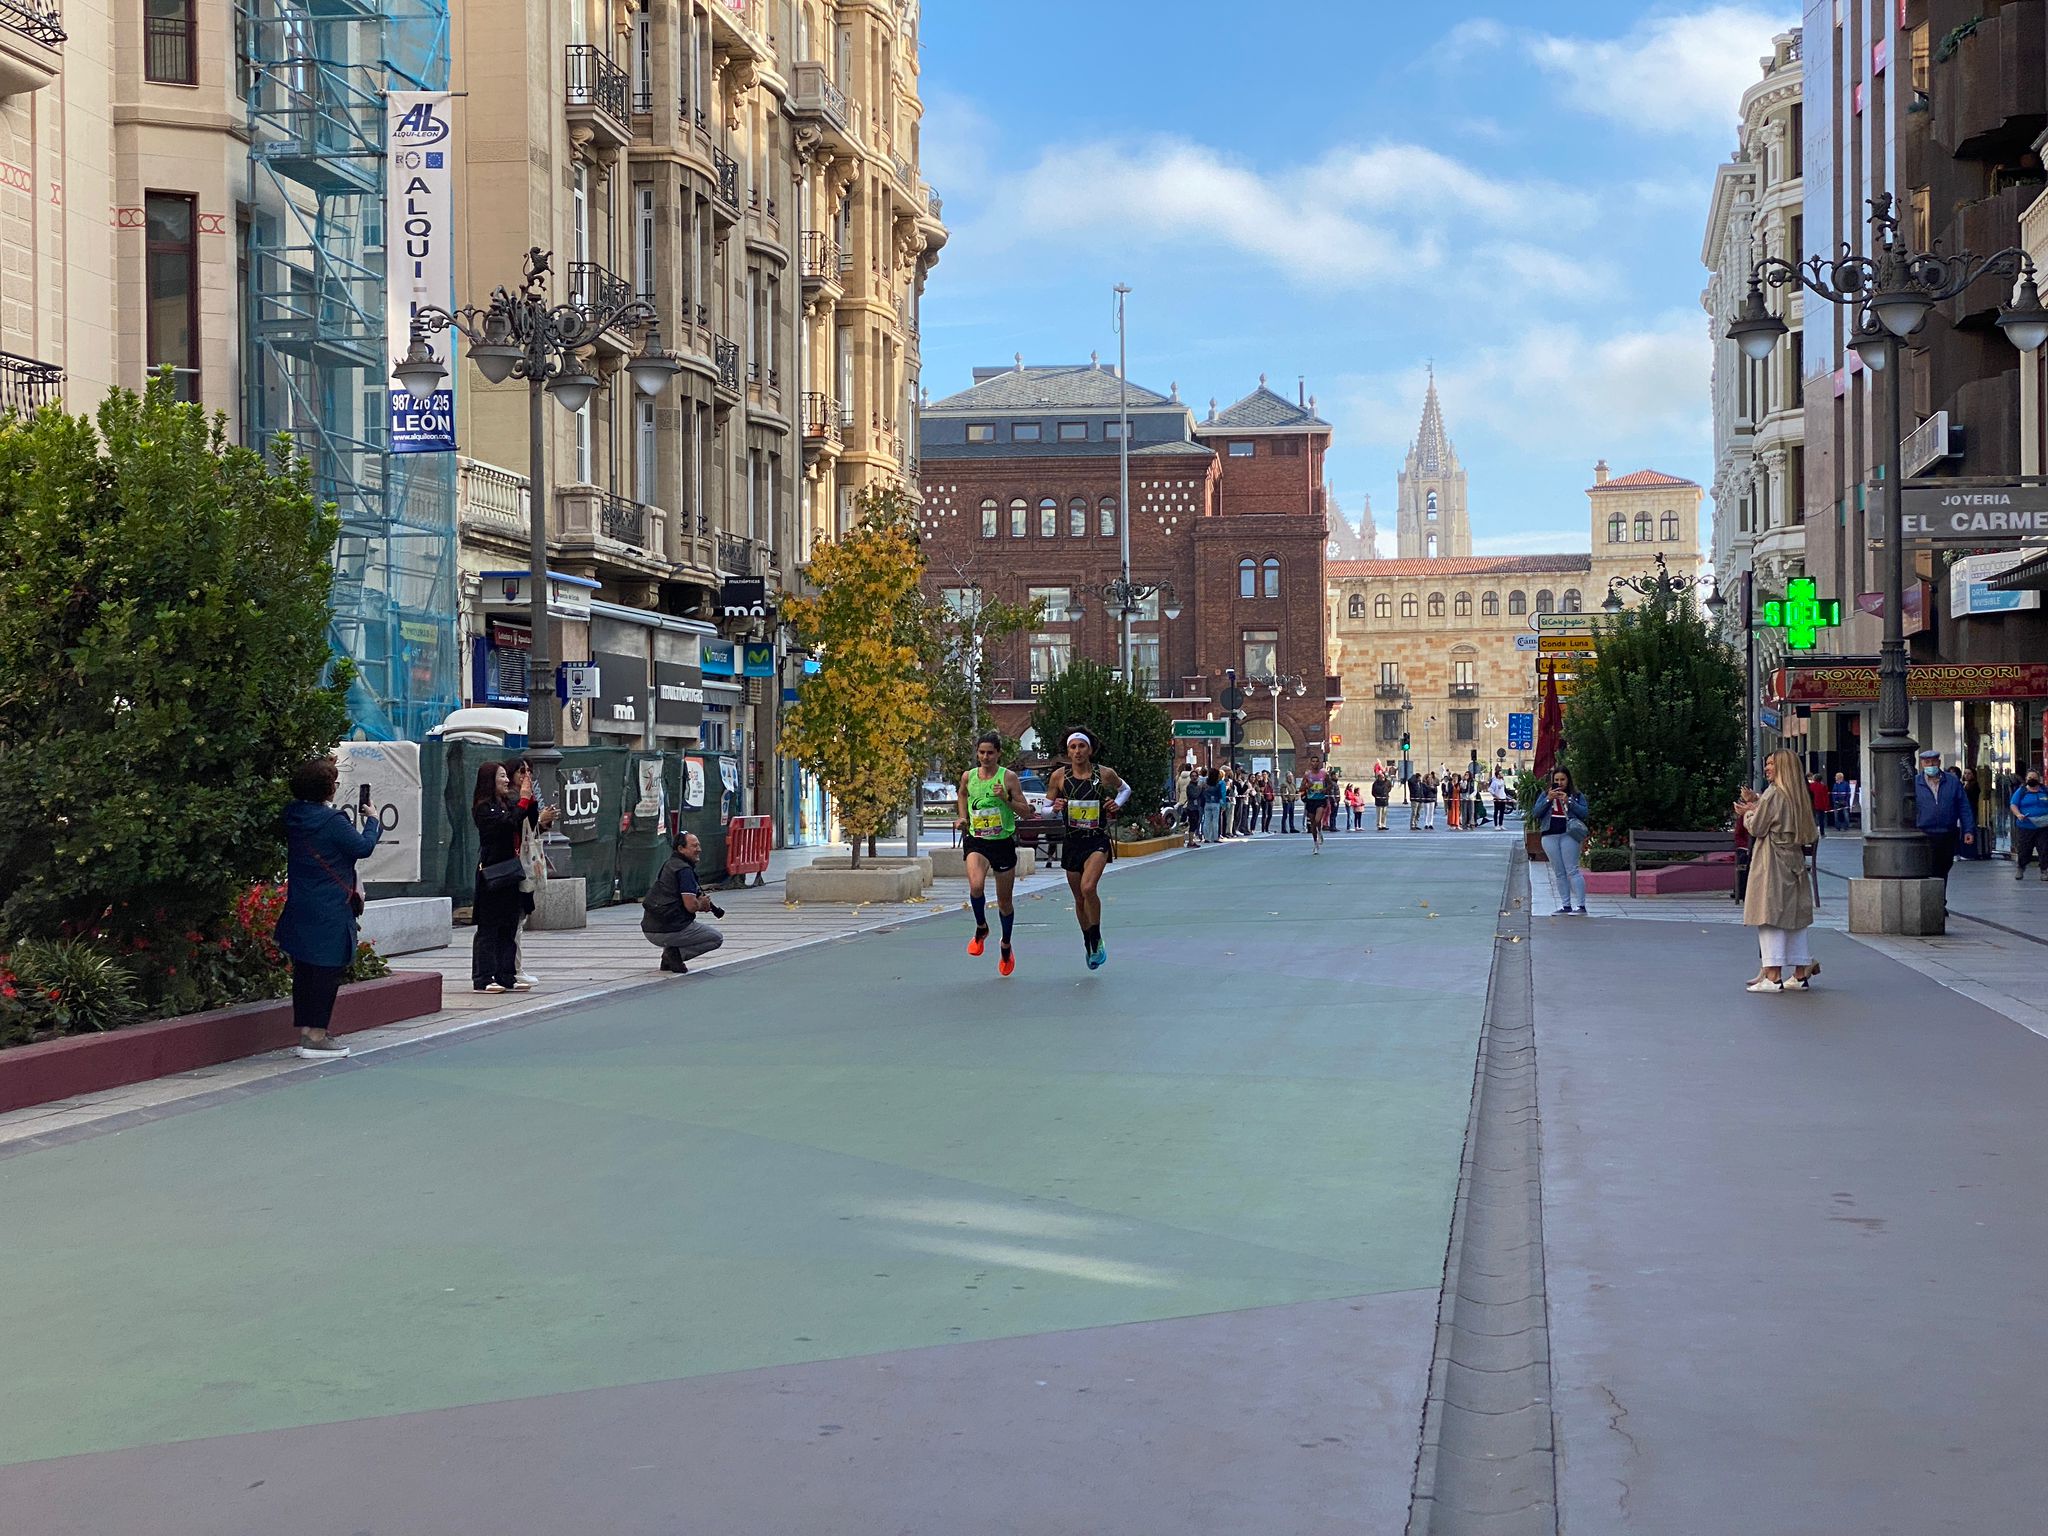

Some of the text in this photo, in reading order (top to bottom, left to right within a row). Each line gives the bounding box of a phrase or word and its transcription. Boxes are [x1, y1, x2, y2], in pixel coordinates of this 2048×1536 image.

[392, 394, 410, 411] 987
[392, 410, 451, 432] LEÓN
[1941, 494, 2010, 506] JOYERIA
[1541, 640, 1566, 648] Conde
[1968, 680, 1994, 688] BAR
[1249, 739, 1274, 747] BBVA
[1081, 809, 1088, 820] 2
[983, 818, 990, 828] 3
